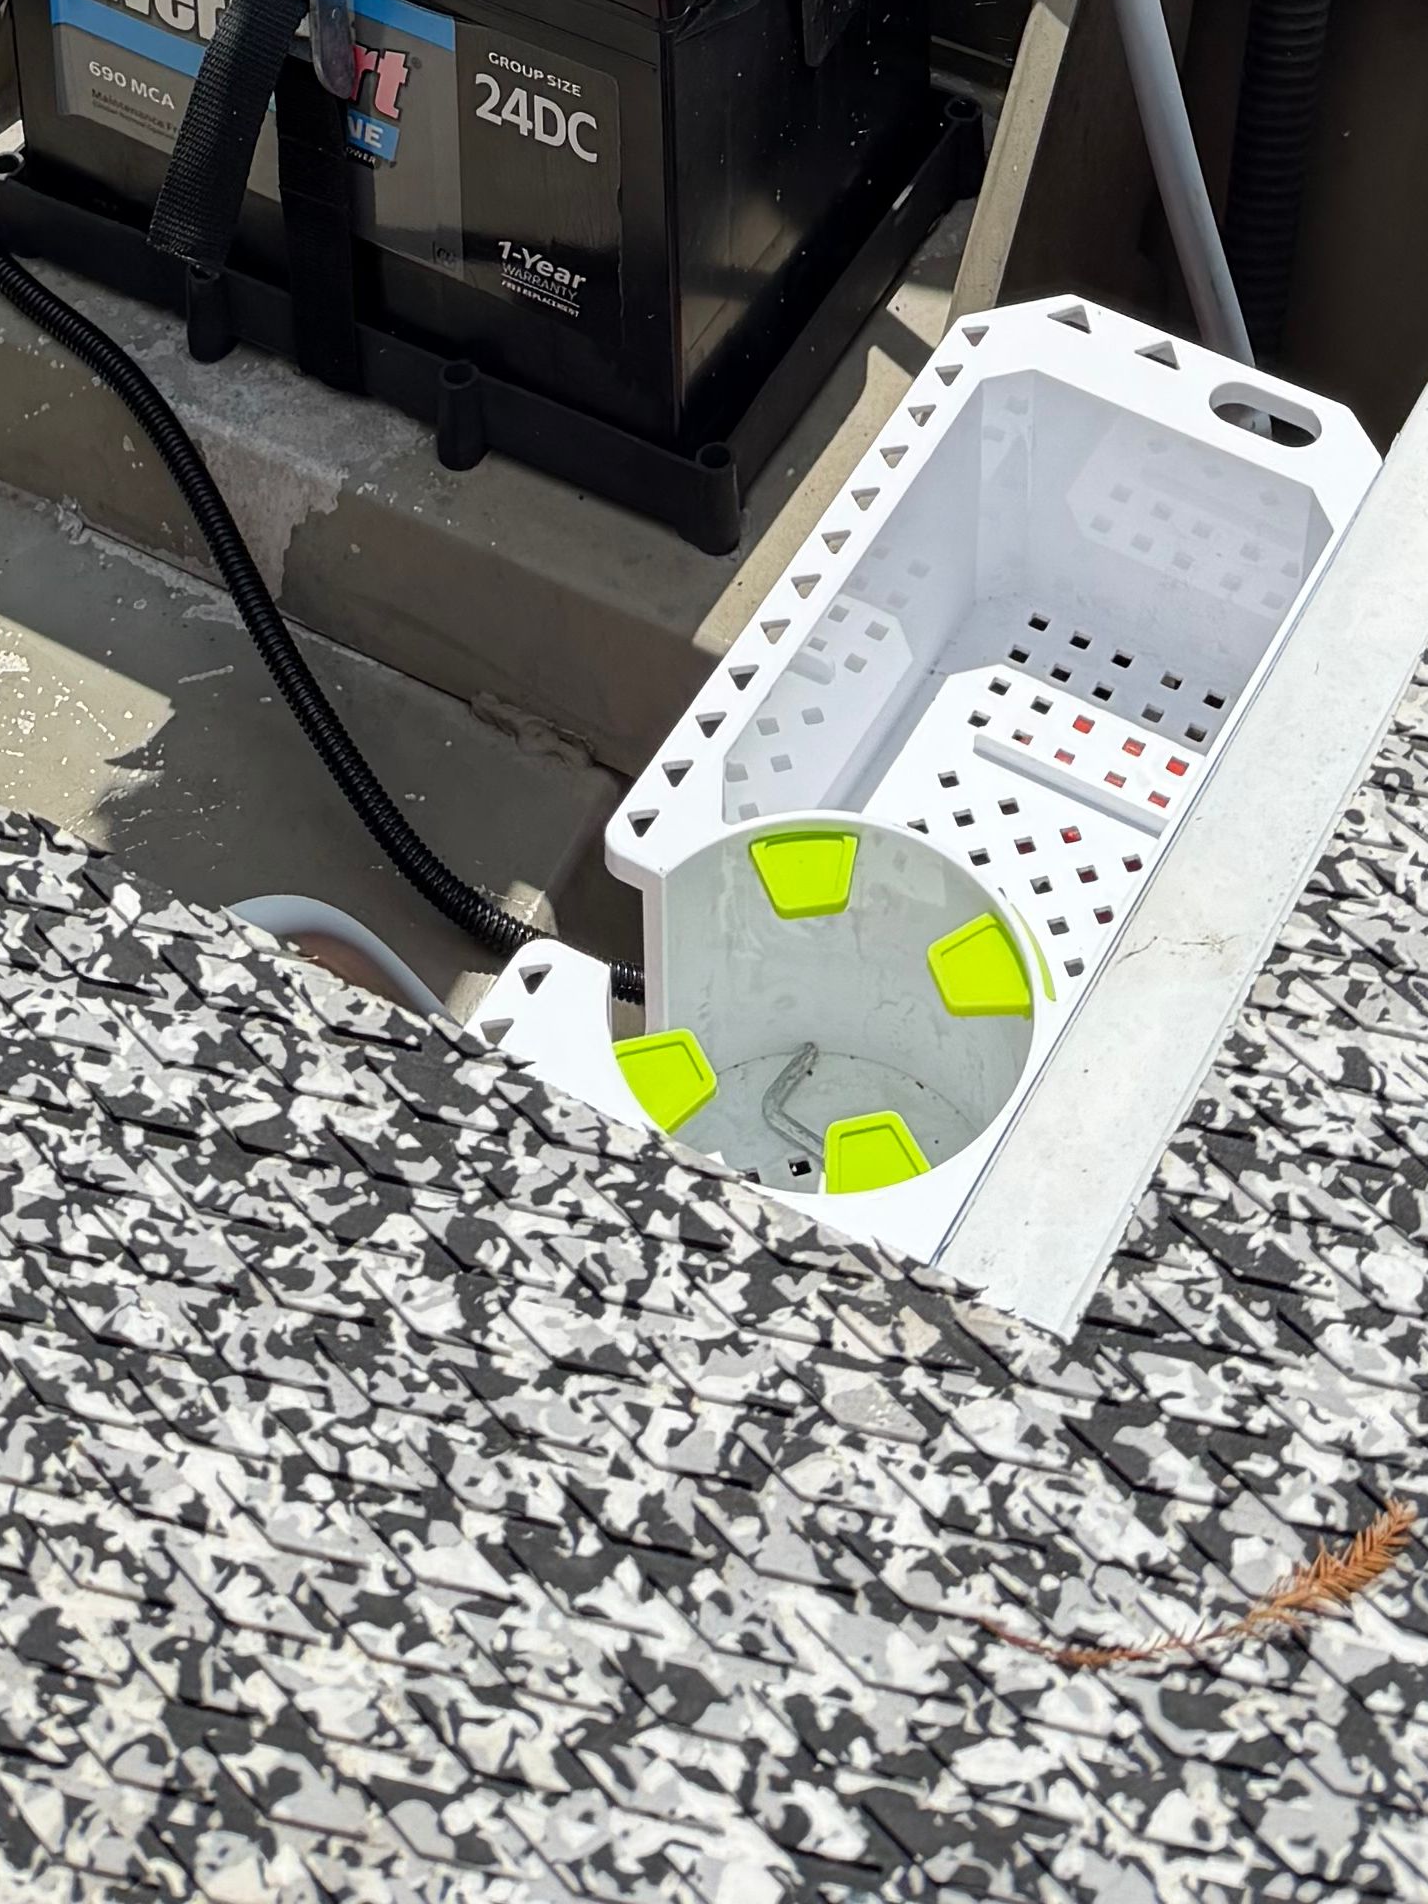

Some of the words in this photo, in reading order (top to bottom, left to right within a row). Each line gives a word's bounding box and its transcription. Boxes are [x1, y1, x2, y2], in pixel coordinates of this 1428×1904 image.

[89, 61, 126, 87] 690
[131, 78, 175, 110] MCA
[488, 52, 544, 80] GROUP
[547, 74, 582, 97] SIZE
[475, 73, 598, 163] 24DC
[498, 241, 587, 289] 1-Year
[502, 262, 578, 301] WARRANTY
